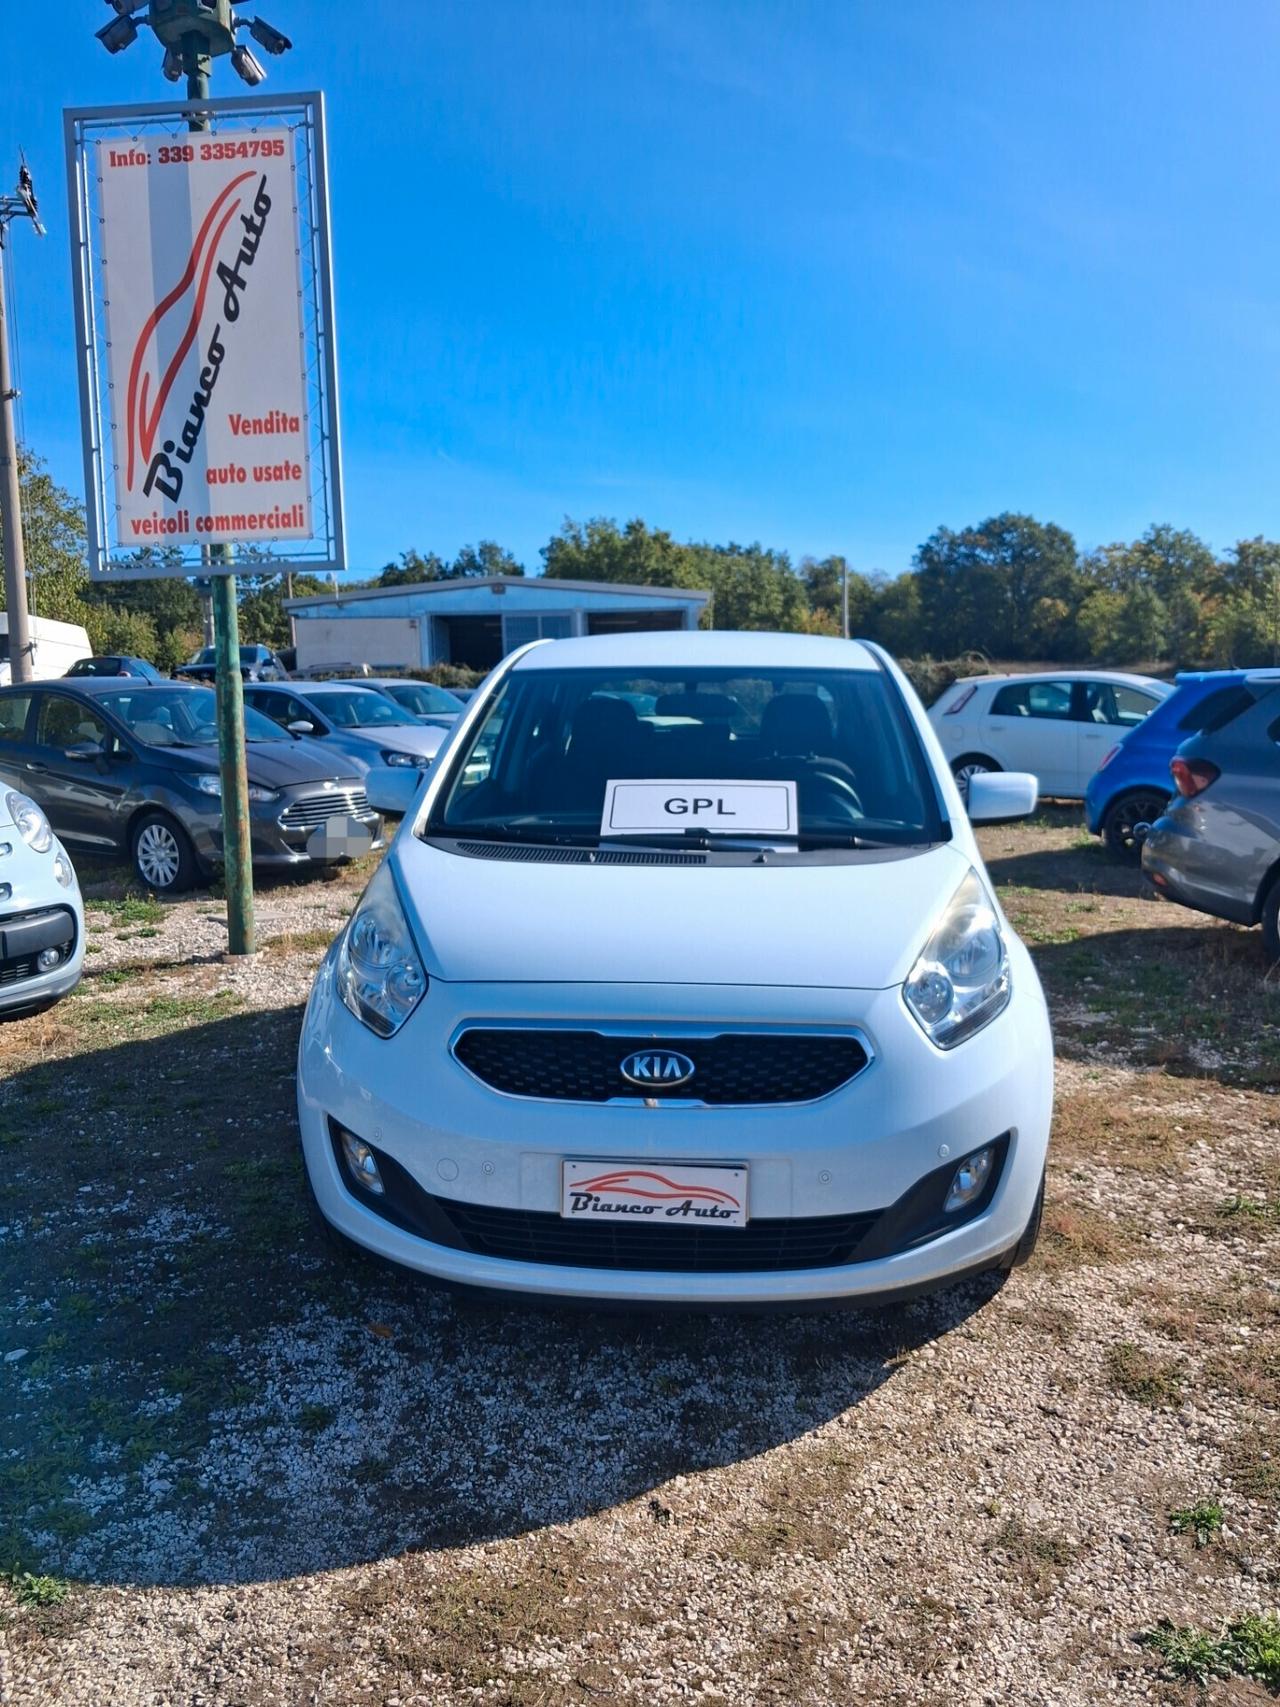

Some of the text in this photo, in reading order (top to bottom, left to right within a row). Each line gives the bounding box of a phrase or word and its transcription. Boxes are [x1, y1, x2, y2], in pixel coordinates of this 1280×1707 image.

[110, 139, 285, 167] Info: 339 3354795
[143, 174, 271, 504] Bianco Auto
[228, 410, 300, 436] Vendita
[206, 460, 302, 485] auto usate
[131, 504, 304, 535] veicoli commerciali
[664, 798, 736, 815] GPL
[633, 1056, 682, 1078] KIA
[569, 1192, 739, 1219] Bianco Auto
